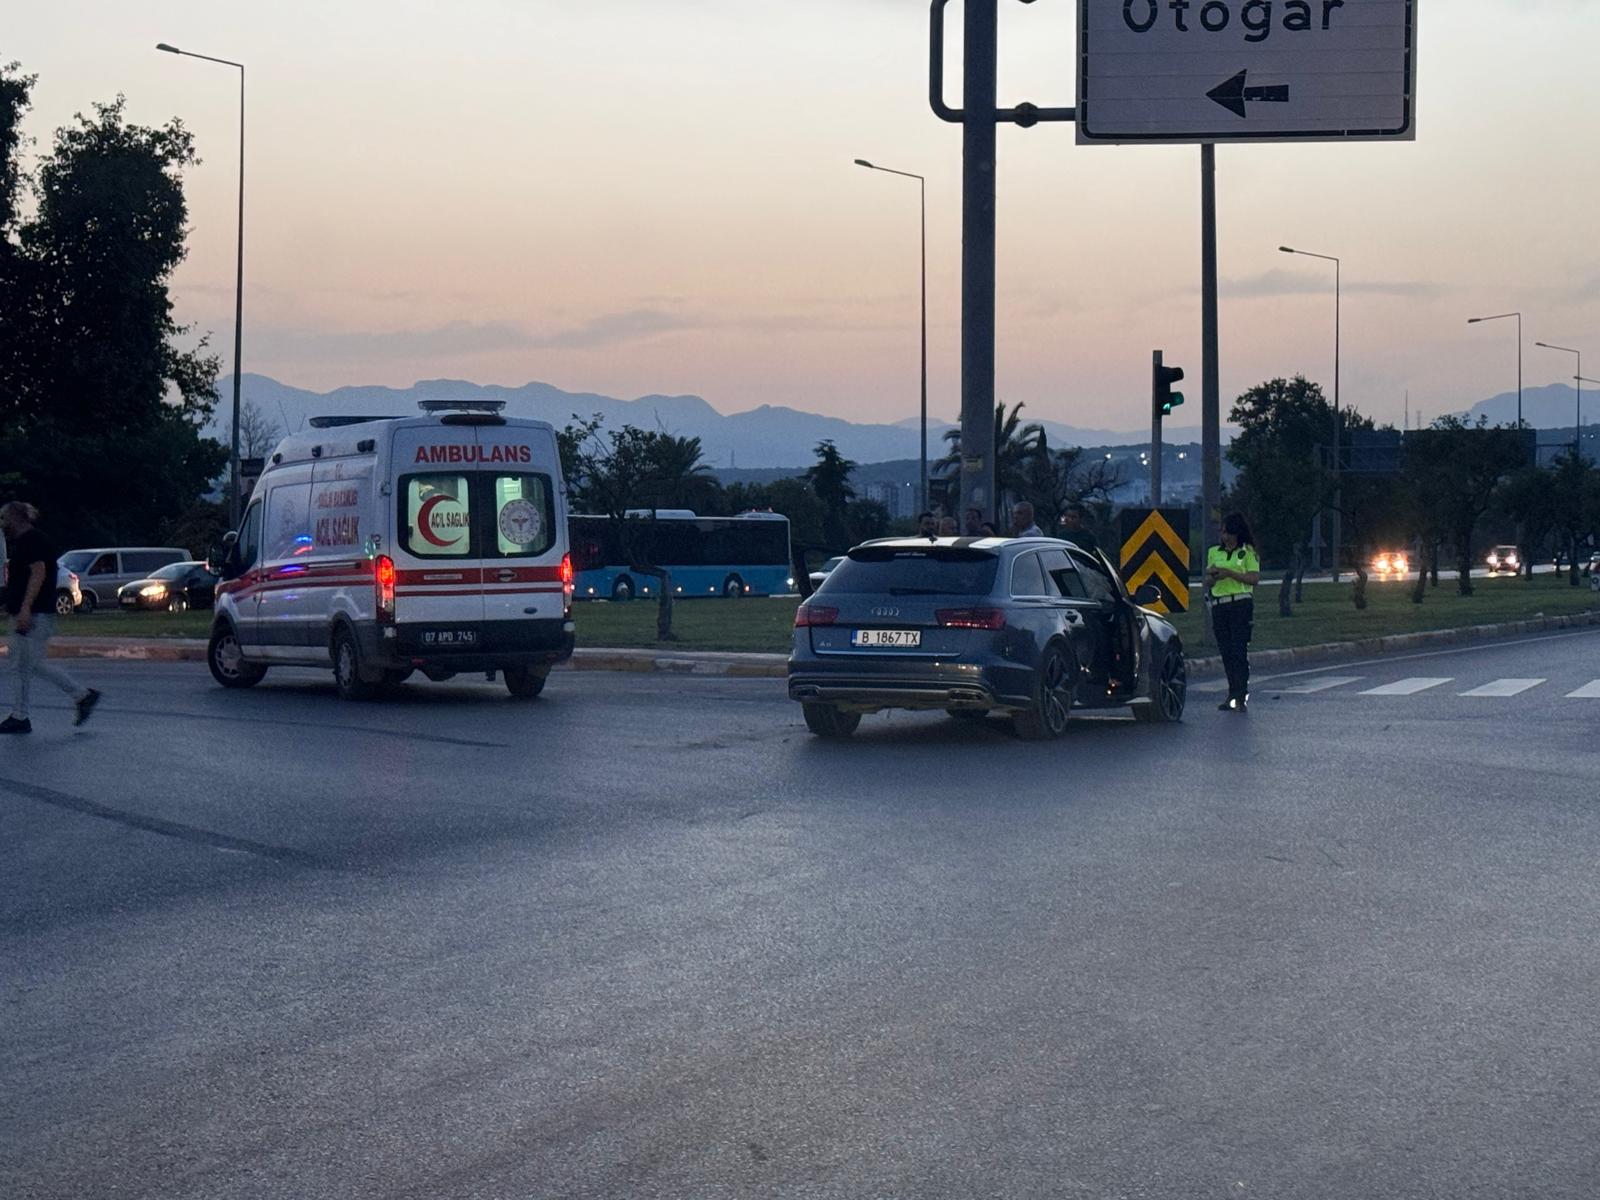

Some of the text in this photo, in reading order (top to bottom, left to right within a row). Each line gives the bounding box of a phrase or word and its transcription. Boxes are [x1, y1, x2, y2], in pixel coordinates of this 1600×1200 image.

[1122, 0, 1345, 43] Otogar
[414, 445, 532, 463] AMBULANS
[425, 631, 436, 642] 07
[862, 631, 918, 644] B 1867 TX
